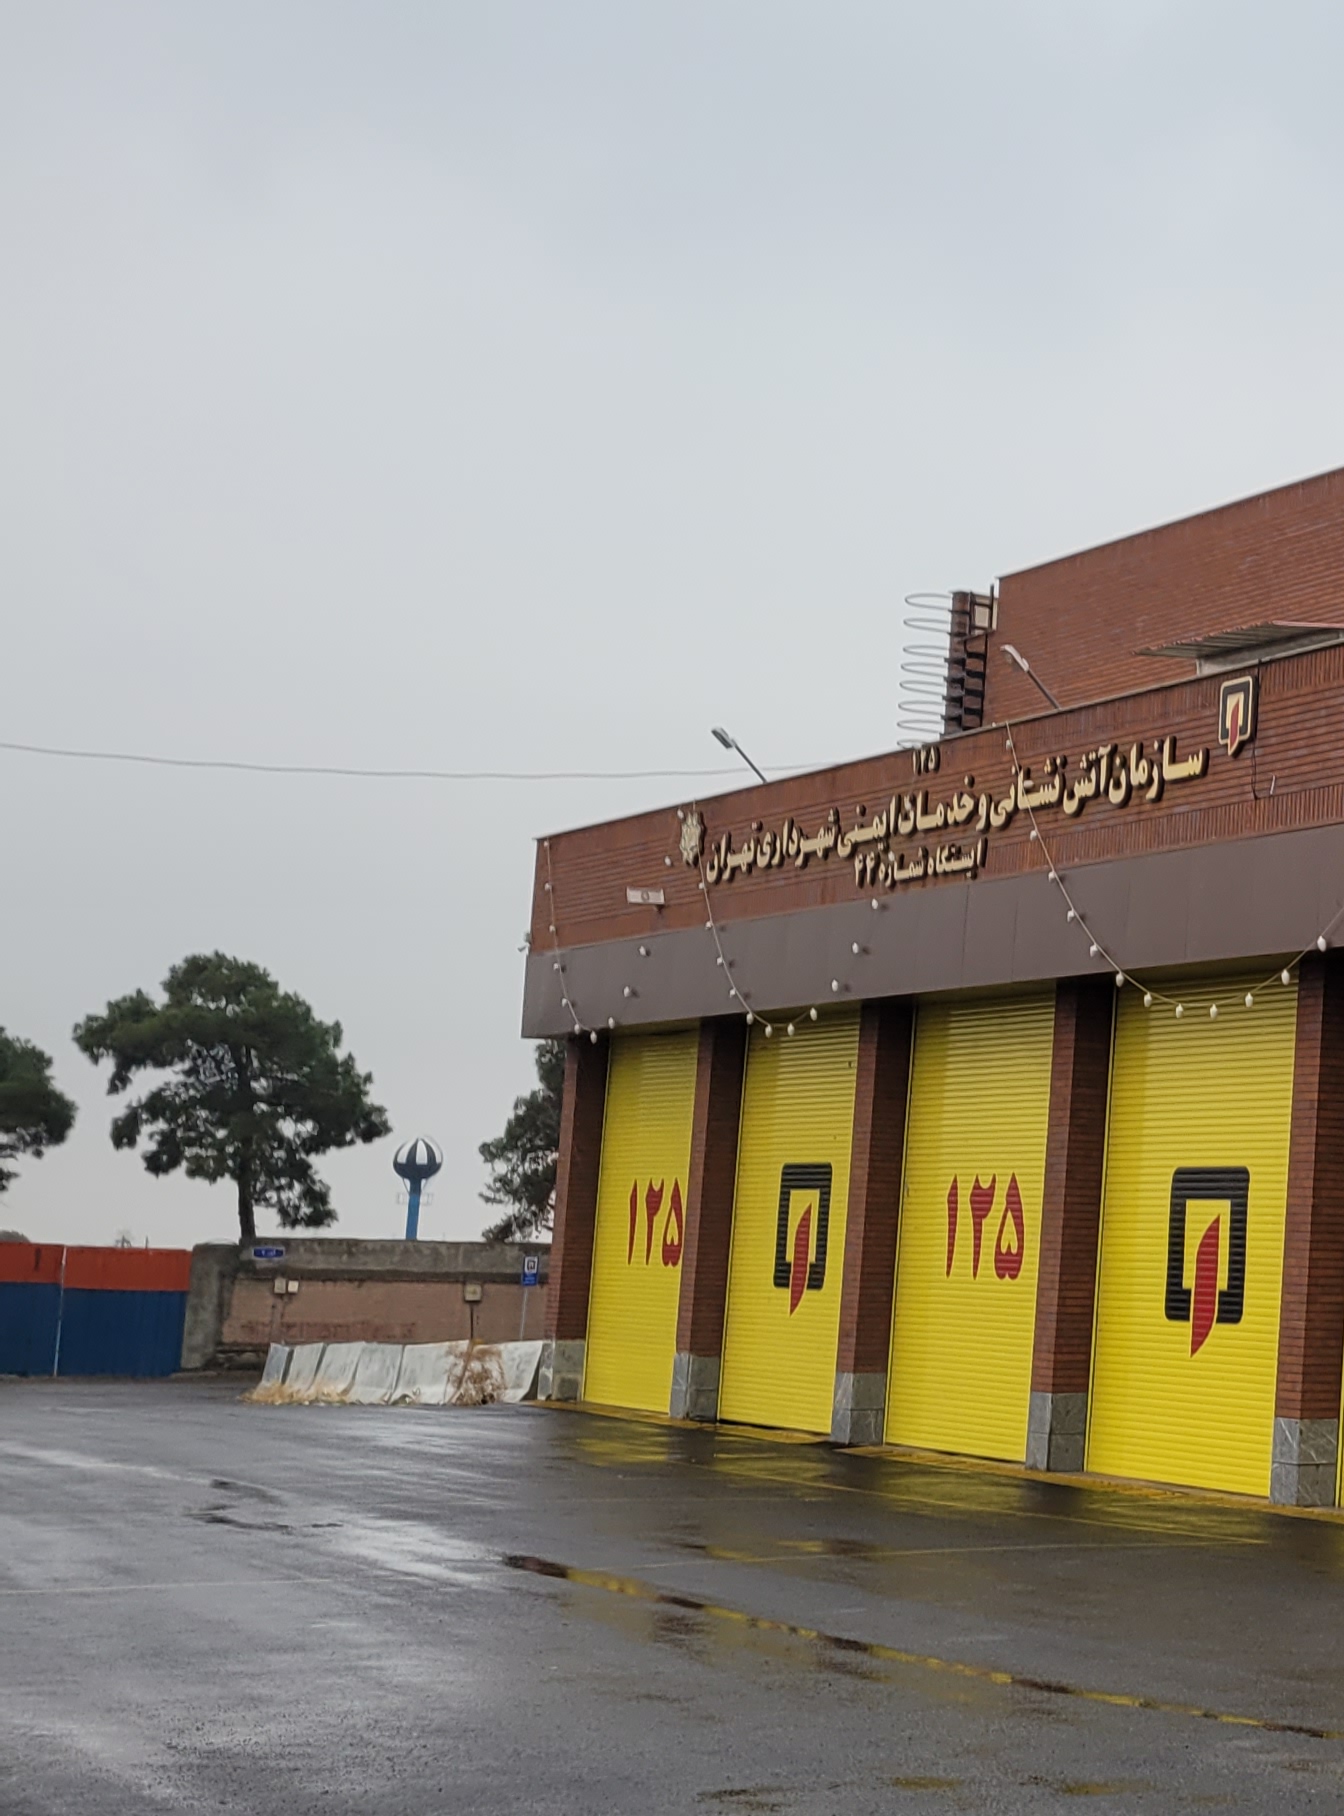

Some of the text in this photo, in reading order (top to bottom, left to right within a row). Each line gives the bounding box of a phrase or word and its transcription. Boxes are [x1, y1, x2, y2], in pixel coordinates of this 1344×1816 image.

[912, 746, 937, 775] ۱۲۵
[706, 735, 1204, 884] سازمان آتش نشانی و خدمات ایمنی شهرداری تهران
[878, 846, 926, 888] شماره
[927, 838, 984, 879] ایستگاه
[627, 1177, 684, 1268] ۱۲۵
[945, 1171, 1025, 1281] ۱۲۵
